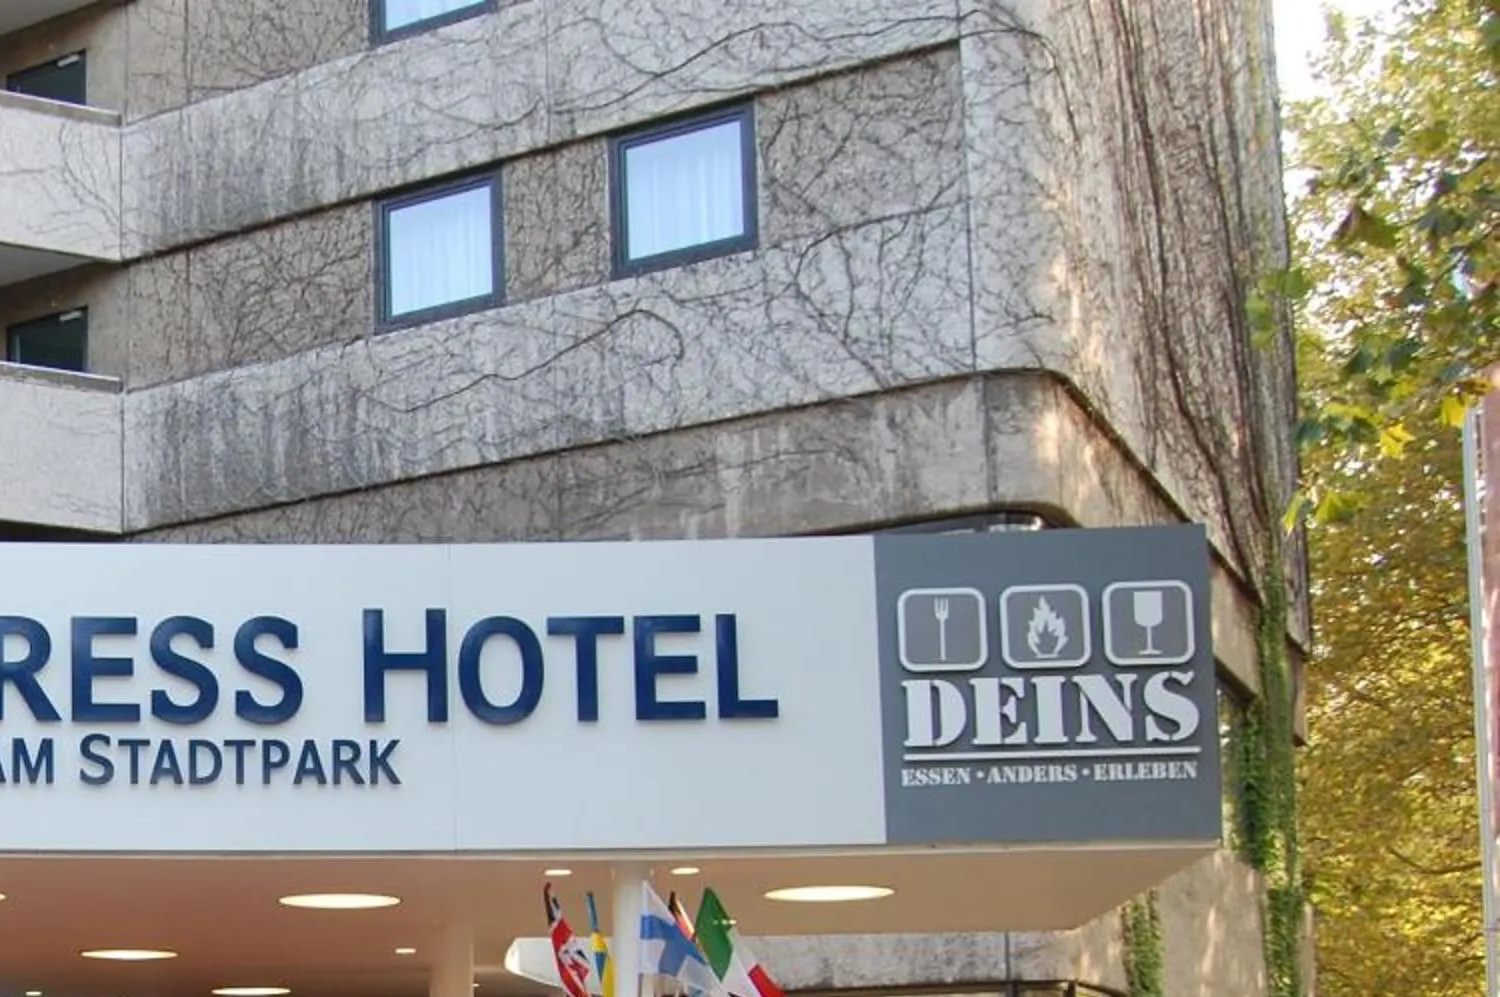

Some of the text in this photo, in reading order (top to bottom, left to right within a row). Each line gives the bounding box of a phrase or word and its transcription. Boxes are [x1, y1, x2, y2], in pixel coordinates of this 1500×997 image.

[363, 608, 779, 724] HOTEL
[901, 670, 1200, 747] DEINS
[78, 732, 402, 786] STADTPARK
